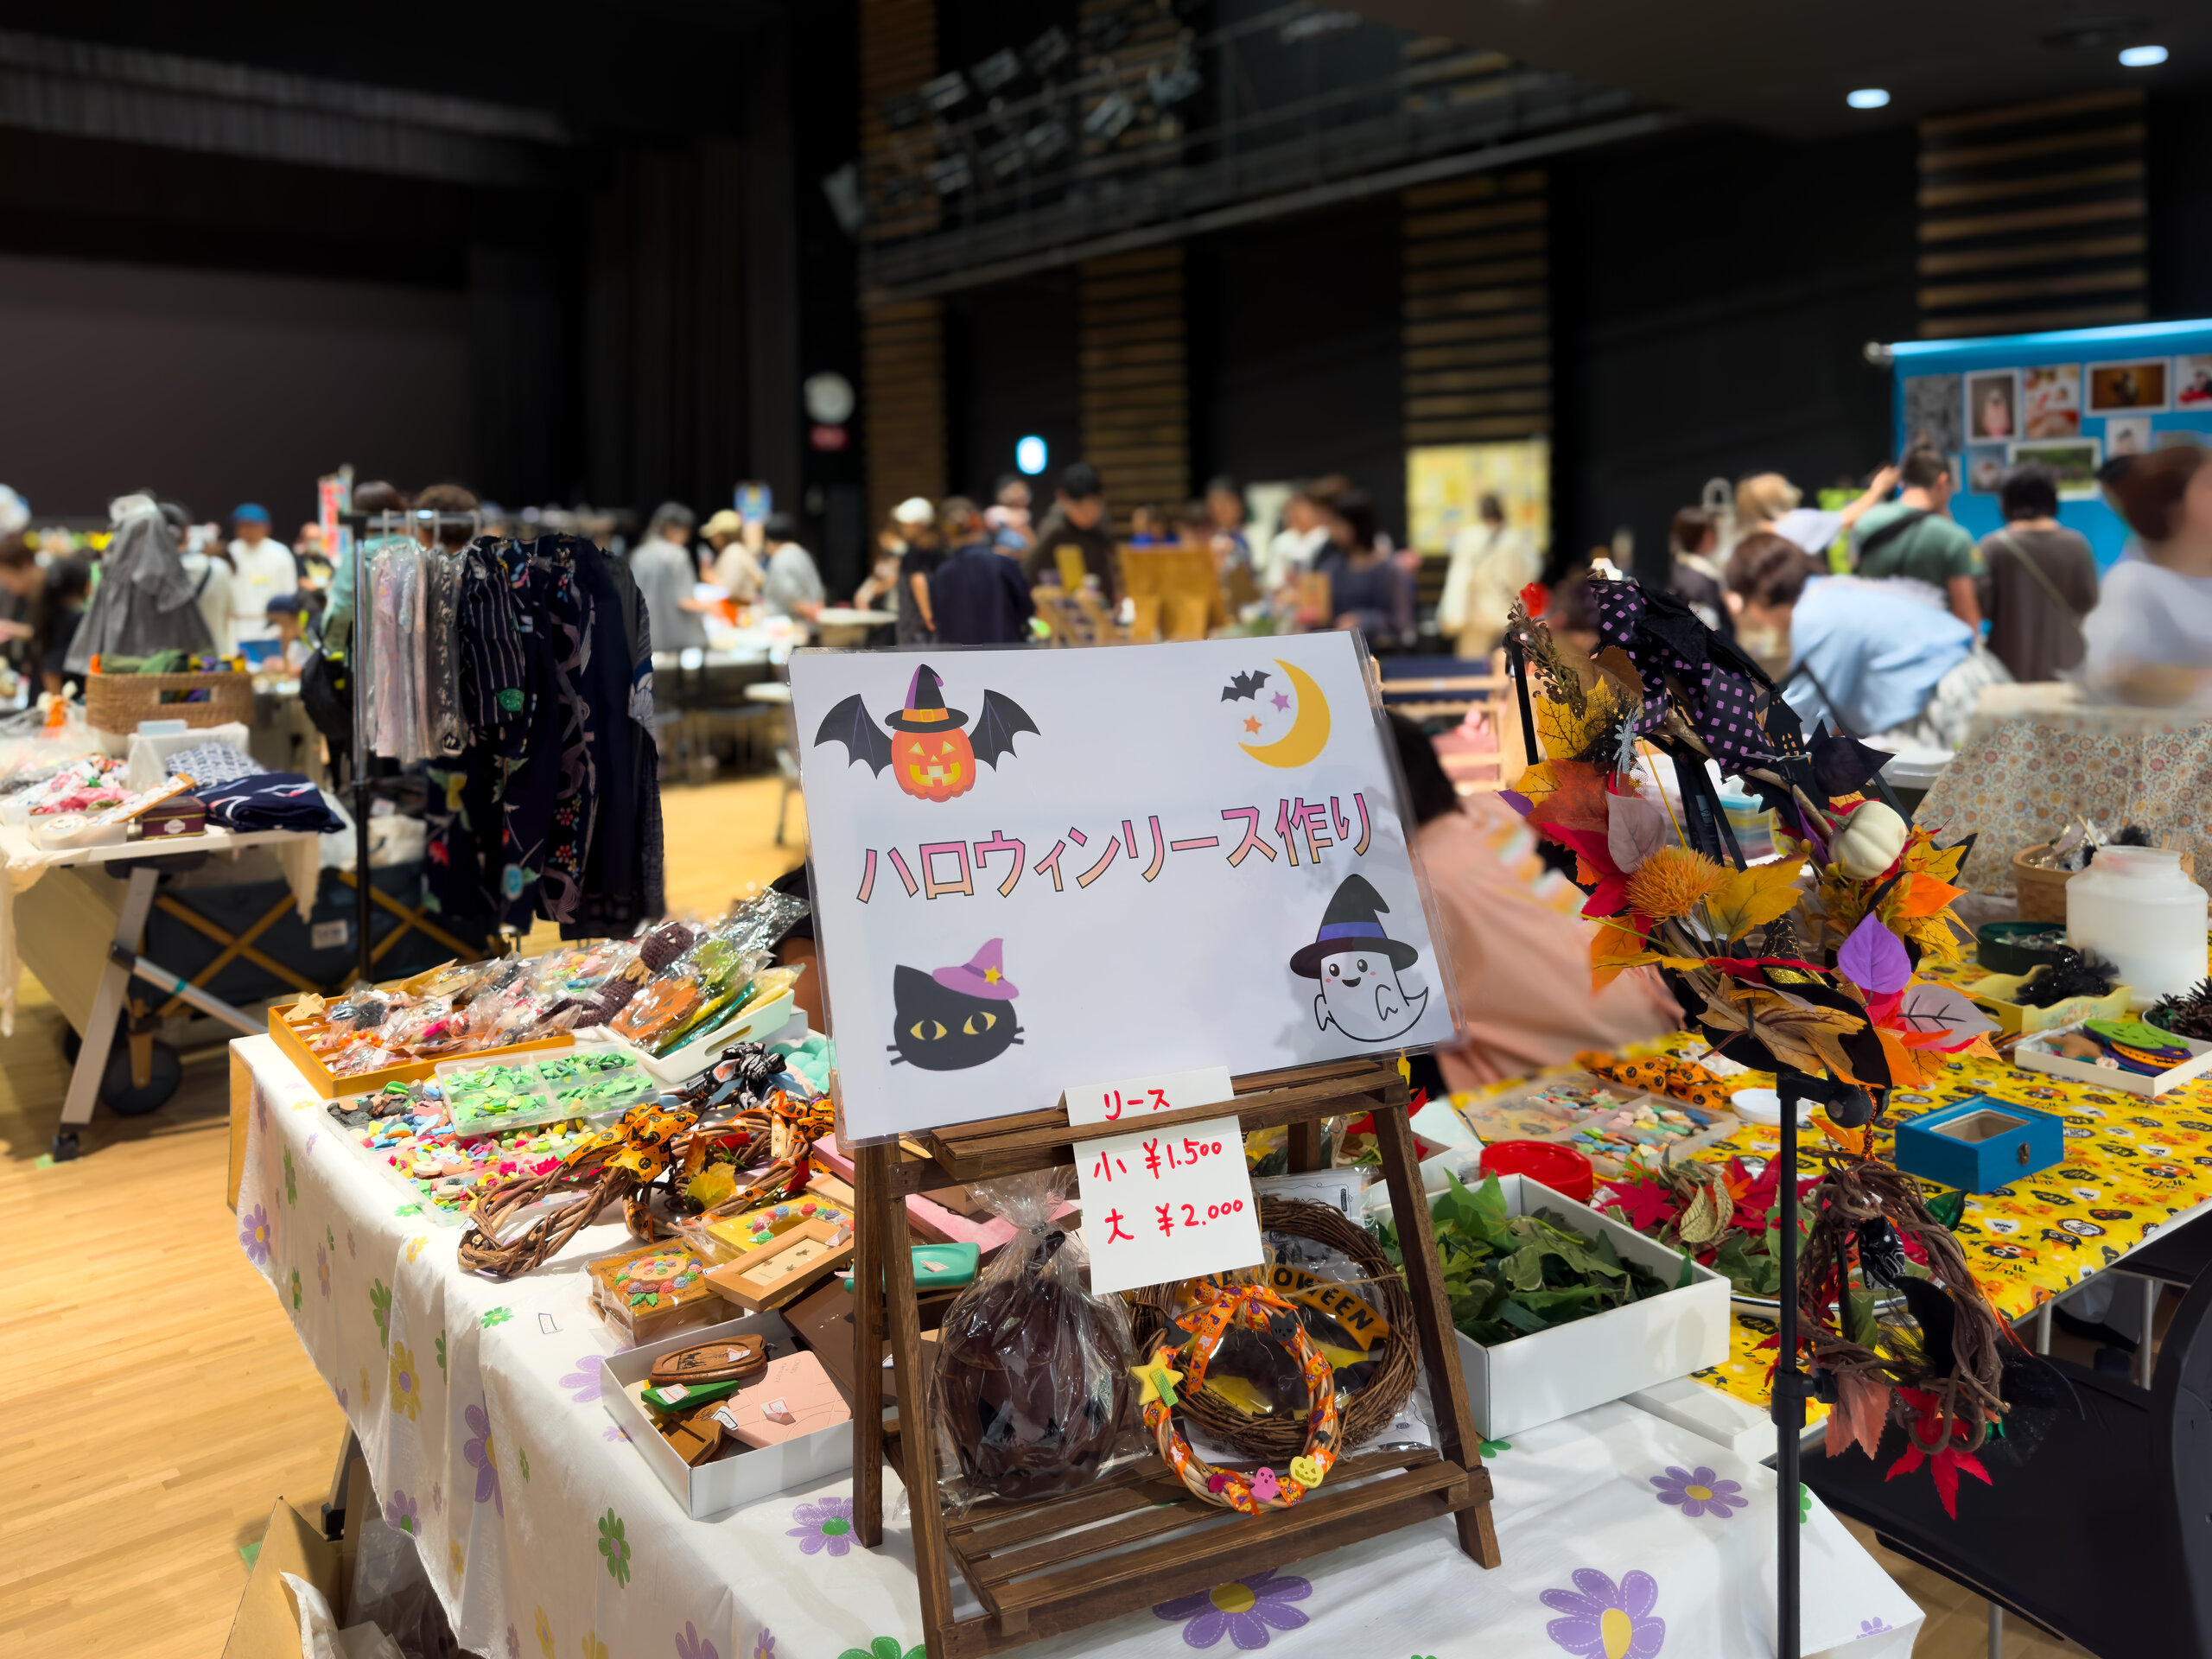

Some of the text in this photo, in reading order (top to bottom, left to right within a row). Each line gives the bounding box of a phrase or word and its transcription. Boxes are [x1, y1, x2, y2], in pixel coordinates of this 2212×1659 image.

[856, 792, 1371, 904] ハロウィンリース作り
[1103, 1089, 1171, 1121] リース
[1093, 1151, 1127, 1182] 小
[1104, 1208, 1135, 1244] 大
[1207, 1268, 1374, 1331] OWEEN
